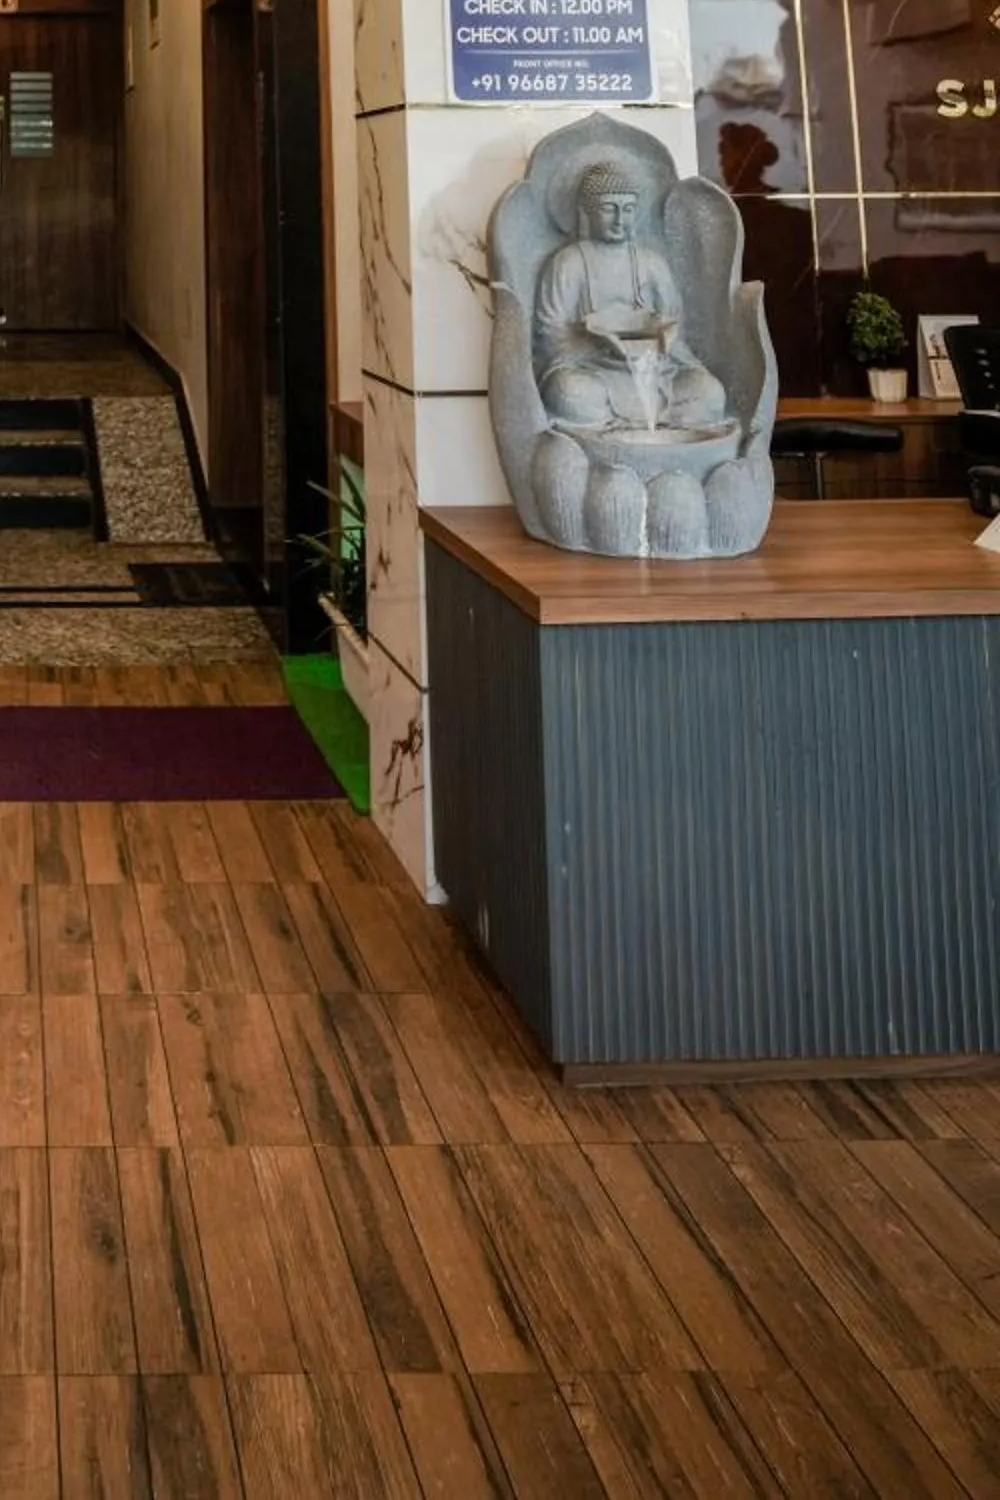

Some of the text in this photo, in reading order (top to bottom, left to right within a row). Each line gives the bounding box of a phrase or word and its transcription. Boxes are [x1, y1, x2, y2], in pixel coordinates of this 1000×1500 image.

[456, 27, 519, 44] CHECK
[522, 27, 560, 44] OUT
[573, 27, 611, 44] 11.00
[615, 27, 644, 44] AM
[471, 74, 633, 92] +91 96687 35222
[936, 79, 997, 117] SJ
